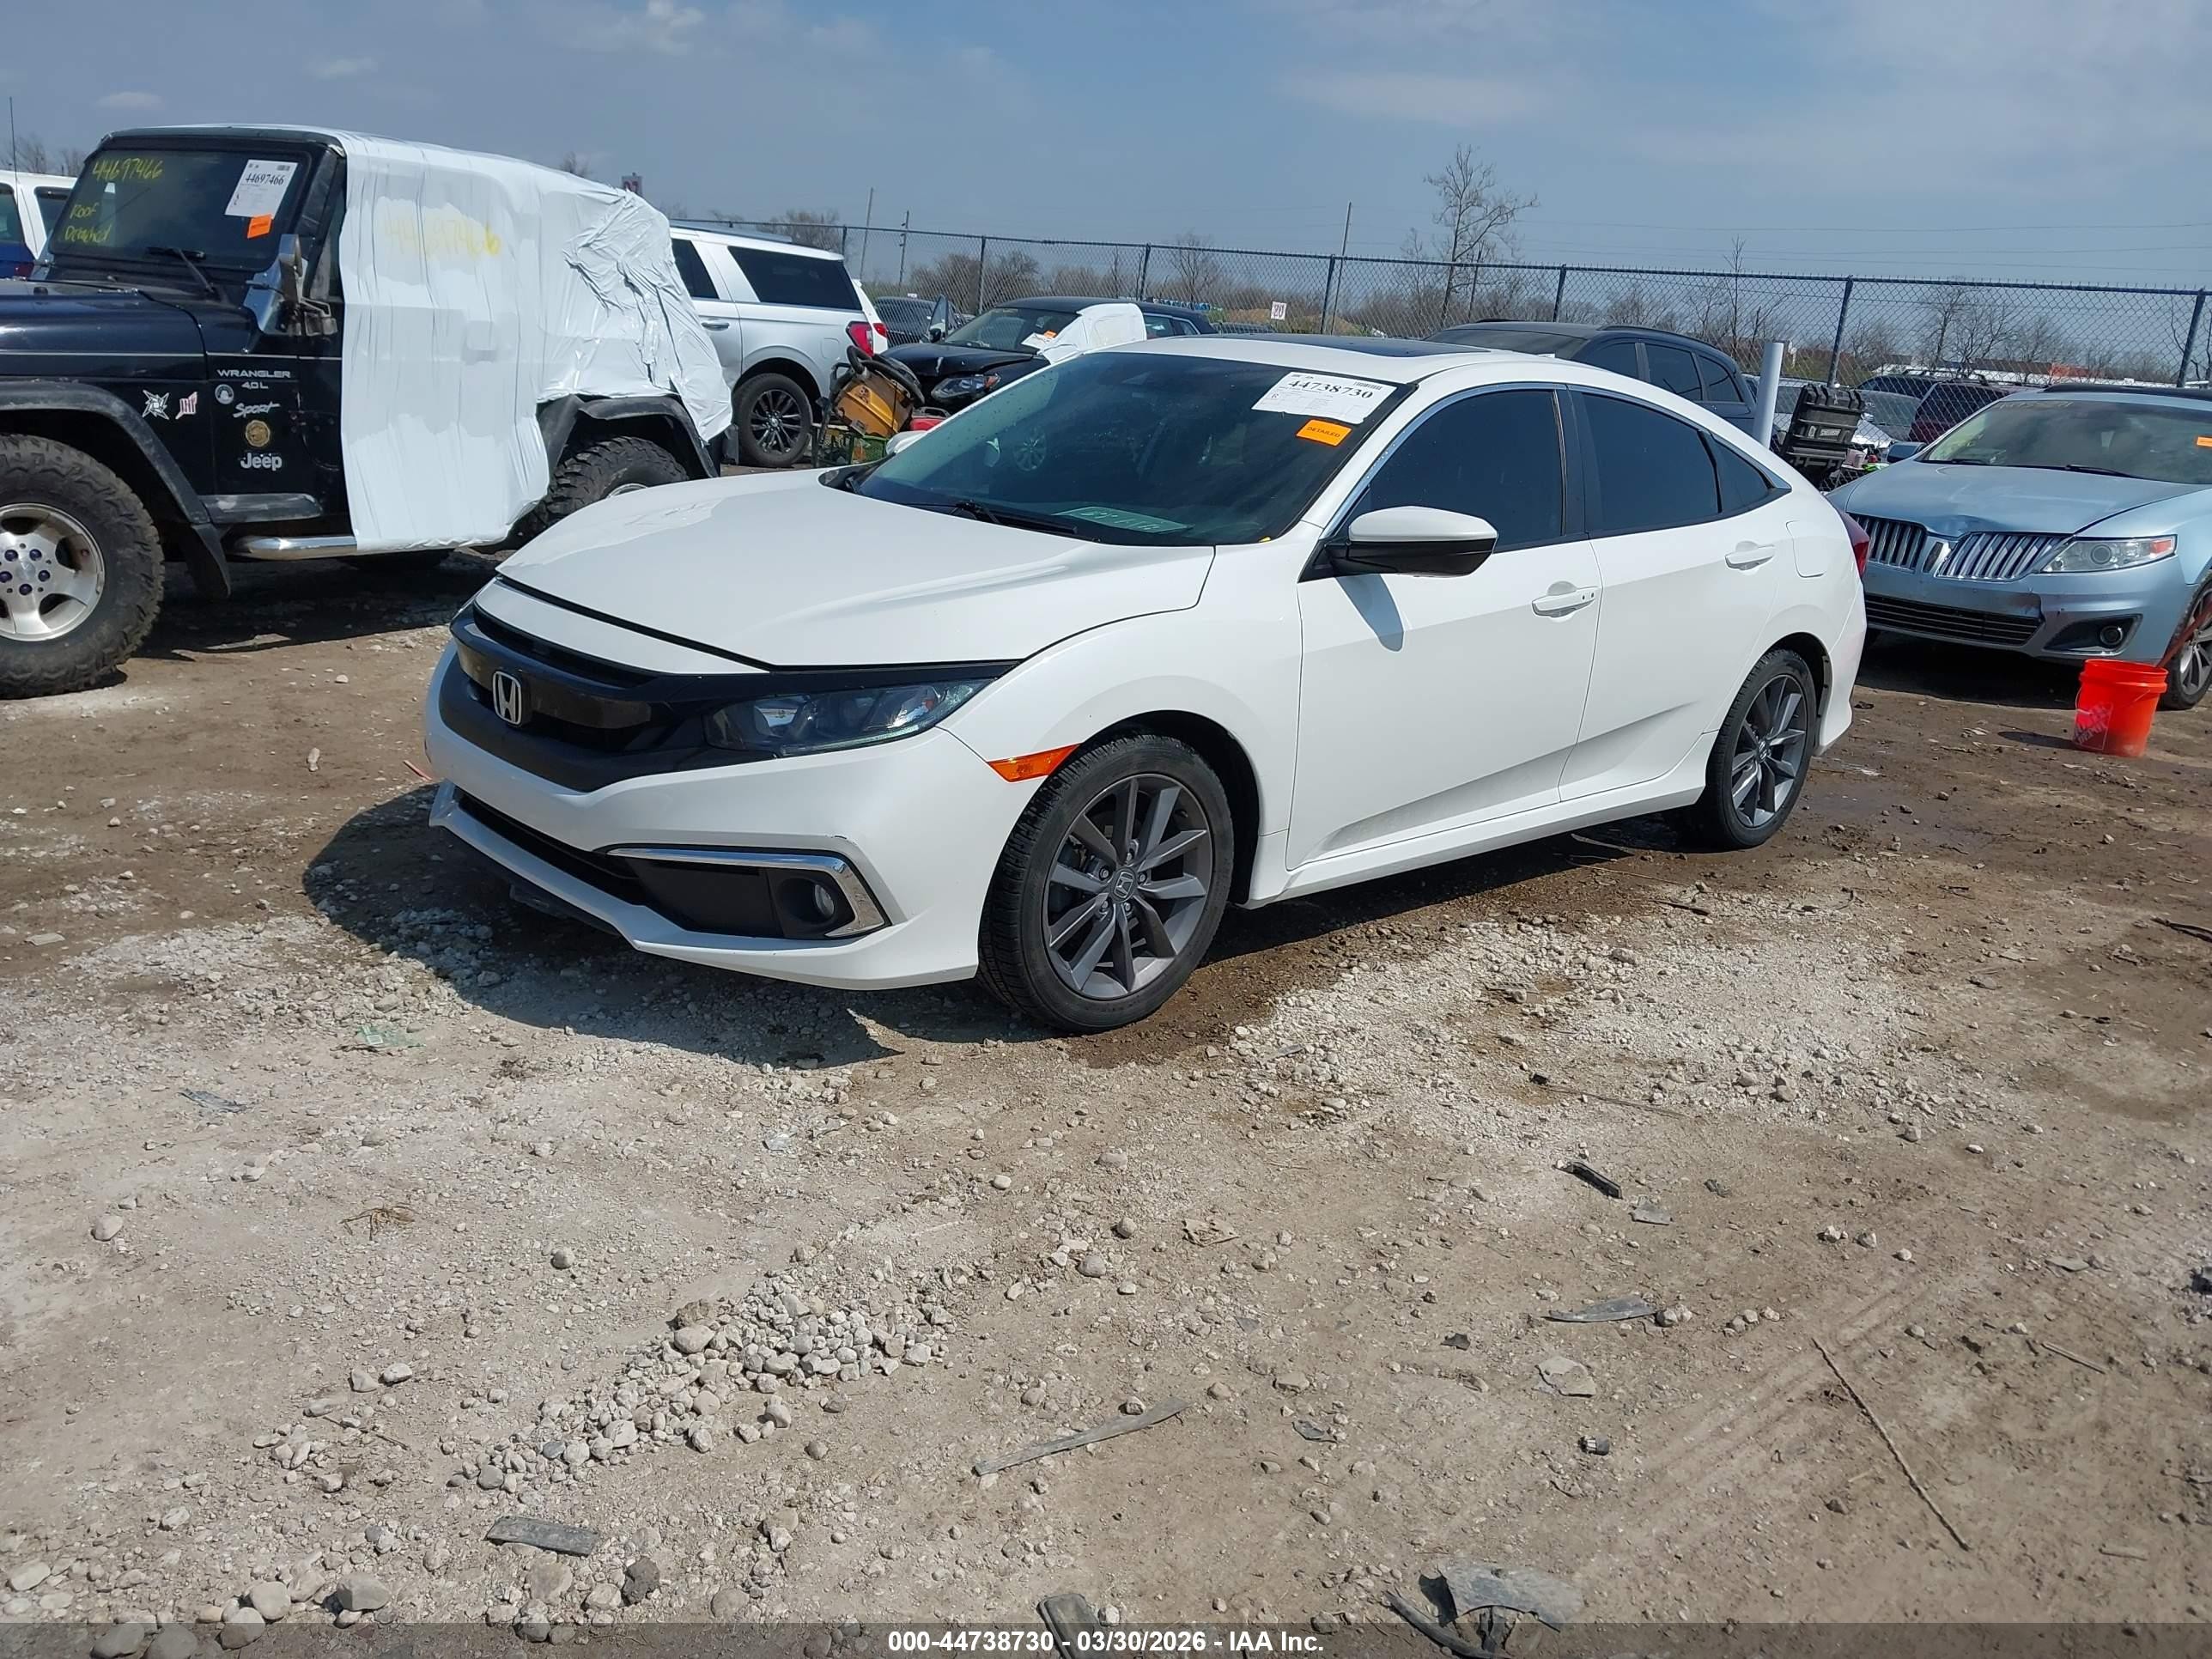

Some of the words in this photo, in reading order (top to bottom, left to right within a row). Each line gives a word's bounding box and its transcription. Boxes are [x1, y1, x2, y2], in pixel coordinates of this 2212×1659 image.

[92, 157, 164, 182] 44697466
[246, 173, 285, 185] 44697466
[216, 369, 290, 378] WRANGLER
[1288, 380, 1374, 399] 44738730
[233, 401, 281, 418] Sport
[1306, 426, 1340, 438] DETAILED
[240, 453, 283, 471] Jeep
